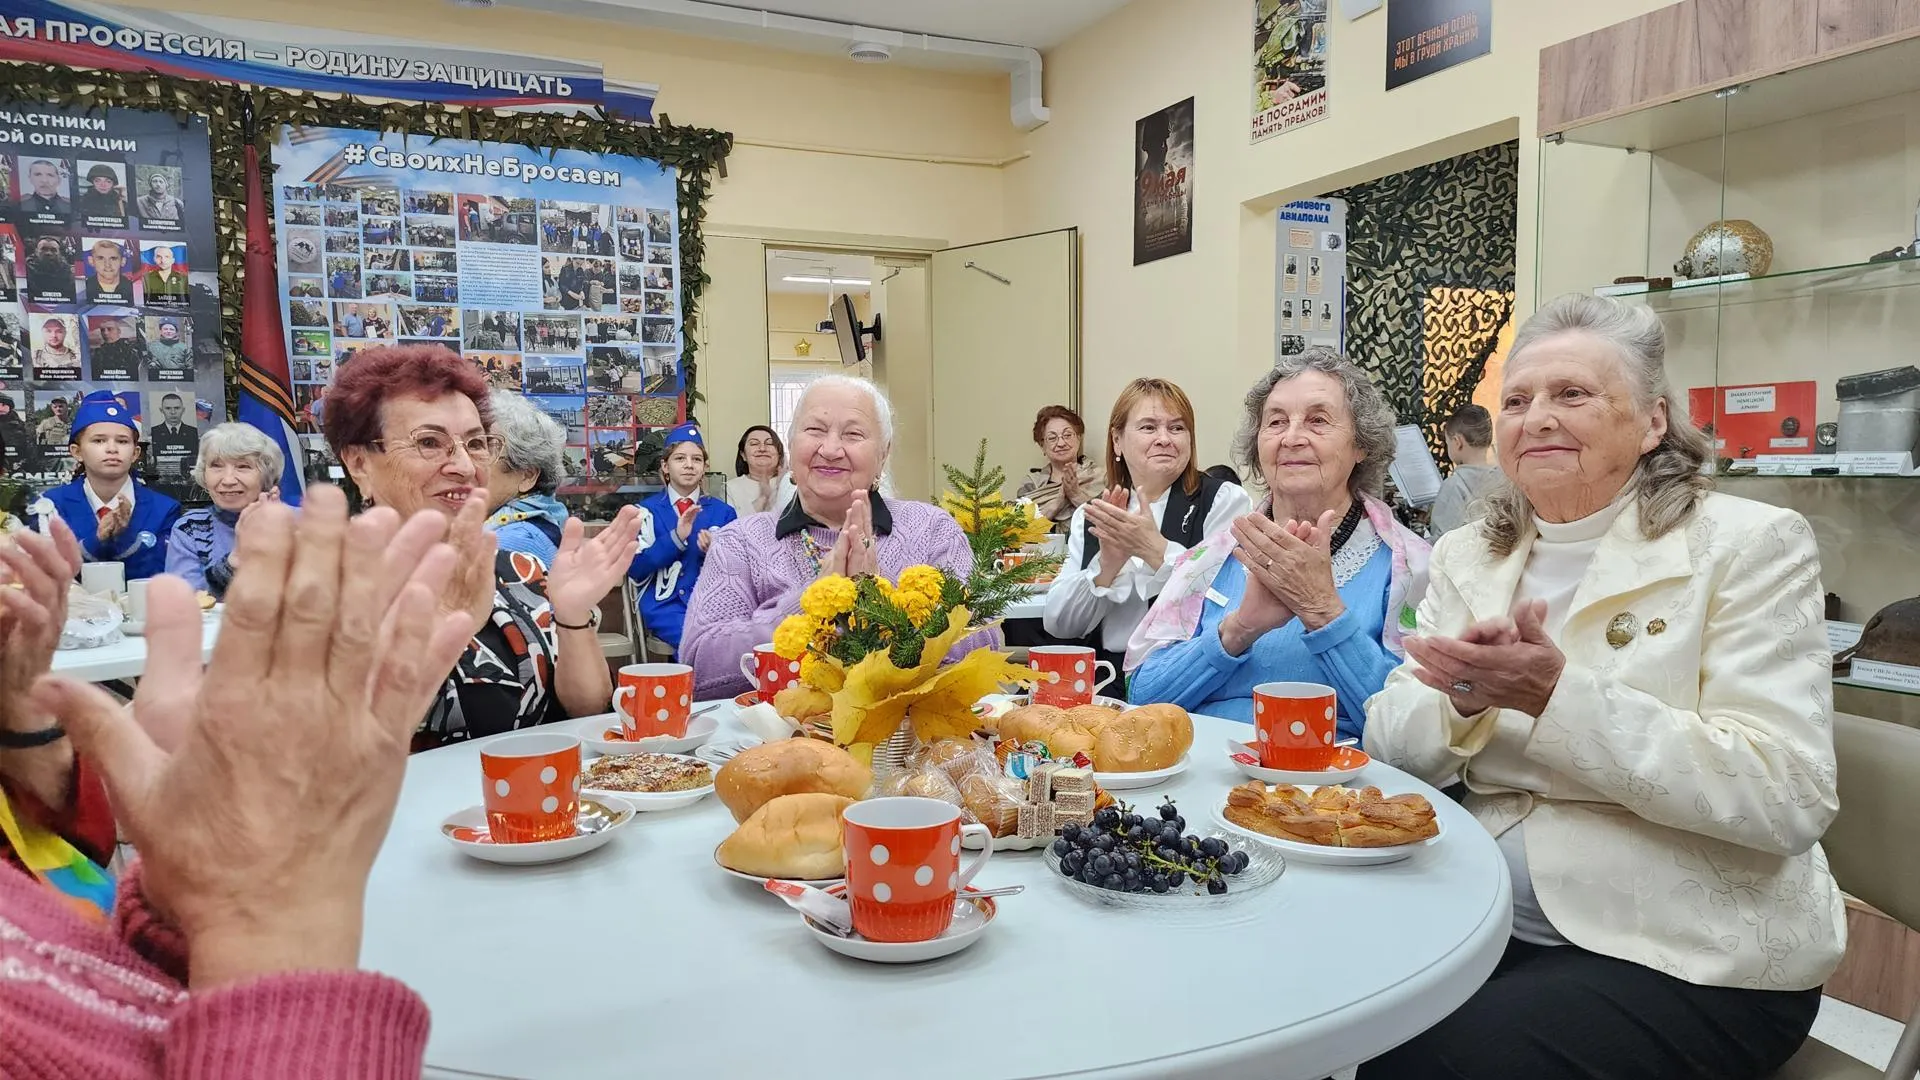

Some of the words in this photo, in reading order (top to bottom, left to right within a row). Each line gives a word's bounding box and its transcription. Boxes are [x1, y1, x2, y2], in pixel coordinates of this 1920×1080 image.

[45, 19, 246, 61] ПРОФЕССИЯ
[286, 46, 408, 79] РОДИНУ
[414, 60, 573, 97] ЗАЩИЩАТЬ
[1394, 54, 1408, 71] МЫ
[1410, 51, 1415, 65] В
[1417, 41, 1441, 62] ГРУДИ
[1443, 26, 1479, 52] ХРАНИМ
[1396, 35, 1416, 55] ЭТОТ
[0, 111, 106, 131] ЧАСТНИКИ
[1252, 115, 1264, 128] НЕ
[1267, 90, 1326, 123] ПОСРАМИМ
[1252, 122, 1282, 139] ПАМЯТЬ
[1285, 104, 1326, 128] ПРЕДКОВ!
[29, 132, 137, 152] ОПЕРАЦИИ
[344, 143, 621, 187] #СвоихНеБросаем
[1280, 211, 1329, 224] АВИАПОЛКА
